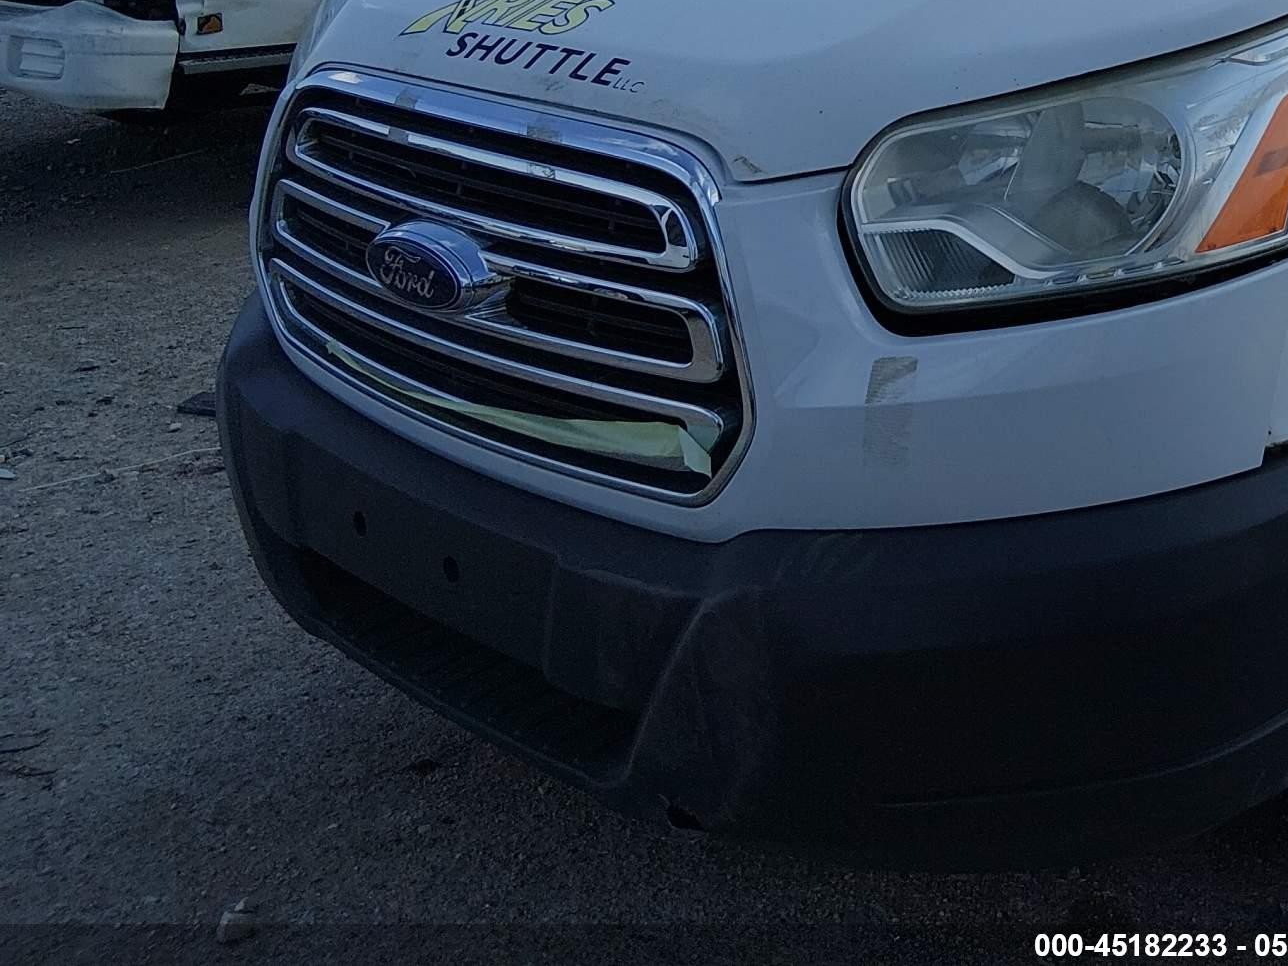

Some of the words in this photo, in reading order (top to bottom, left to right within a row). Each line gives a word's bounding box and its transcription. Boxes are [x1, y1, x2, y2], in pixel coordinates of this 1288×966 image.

[446, 32, 631, 87] SHUTTLE
[612, 76, 648, 94] LLC
[379, 245, 436, 299] Ford
